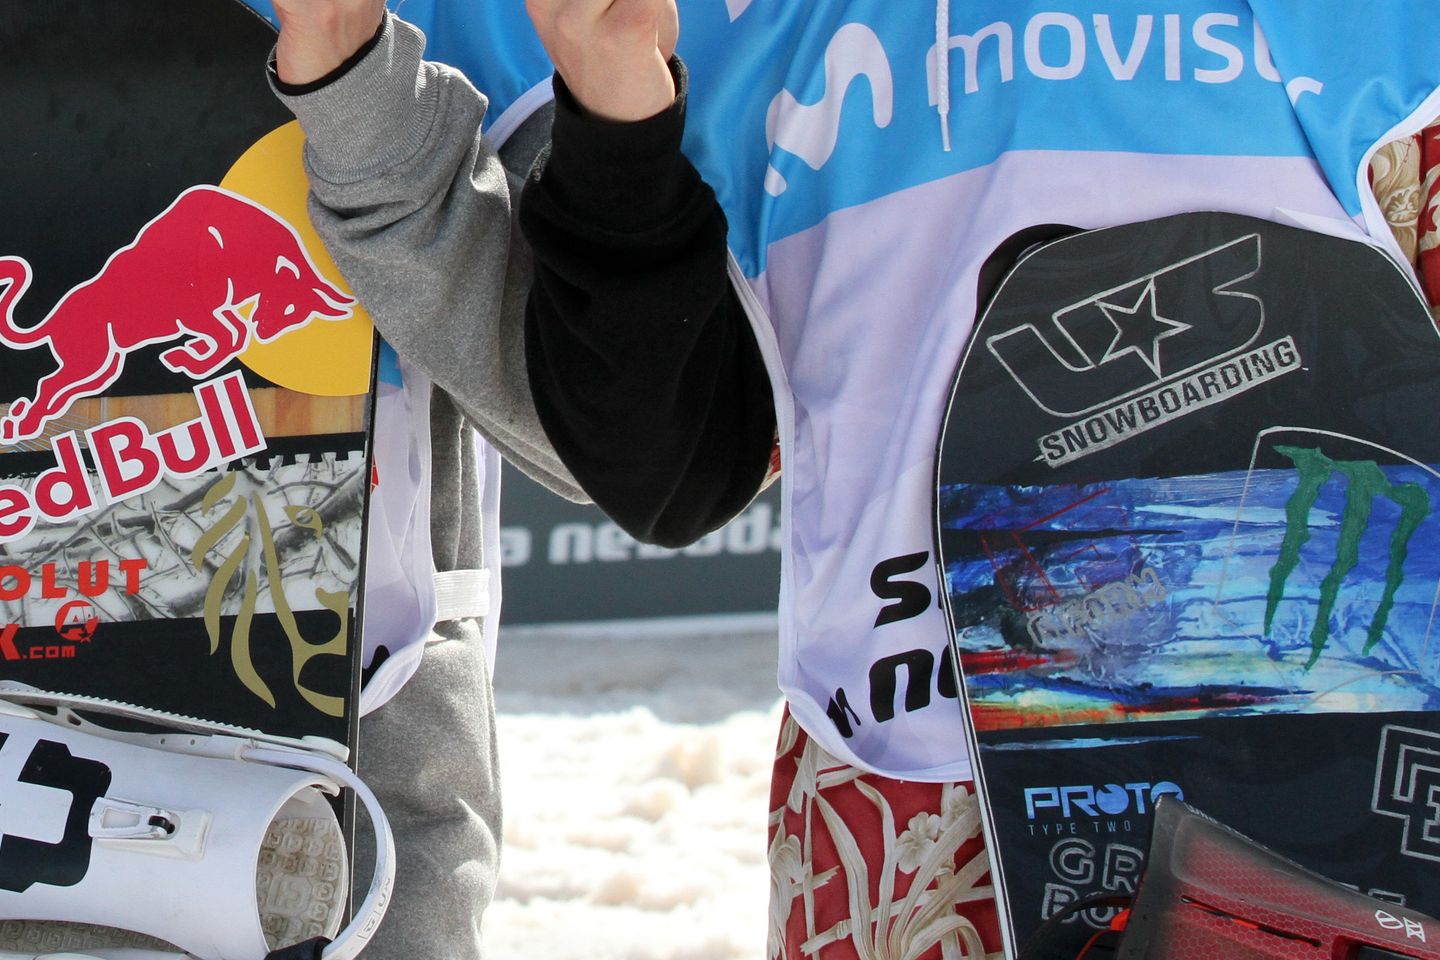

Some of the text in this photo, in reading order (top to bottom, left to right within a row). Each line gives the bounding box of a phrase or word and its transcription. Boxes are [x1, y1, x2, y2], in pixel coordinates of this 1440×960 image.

[92, 374, 262, 498] Bull
[1038, 337, 1301, 466] SNOWBOARDING
[1027, 820, 1131, 837] TYPE TWO
[1049, 838, 1144, 893] GR
